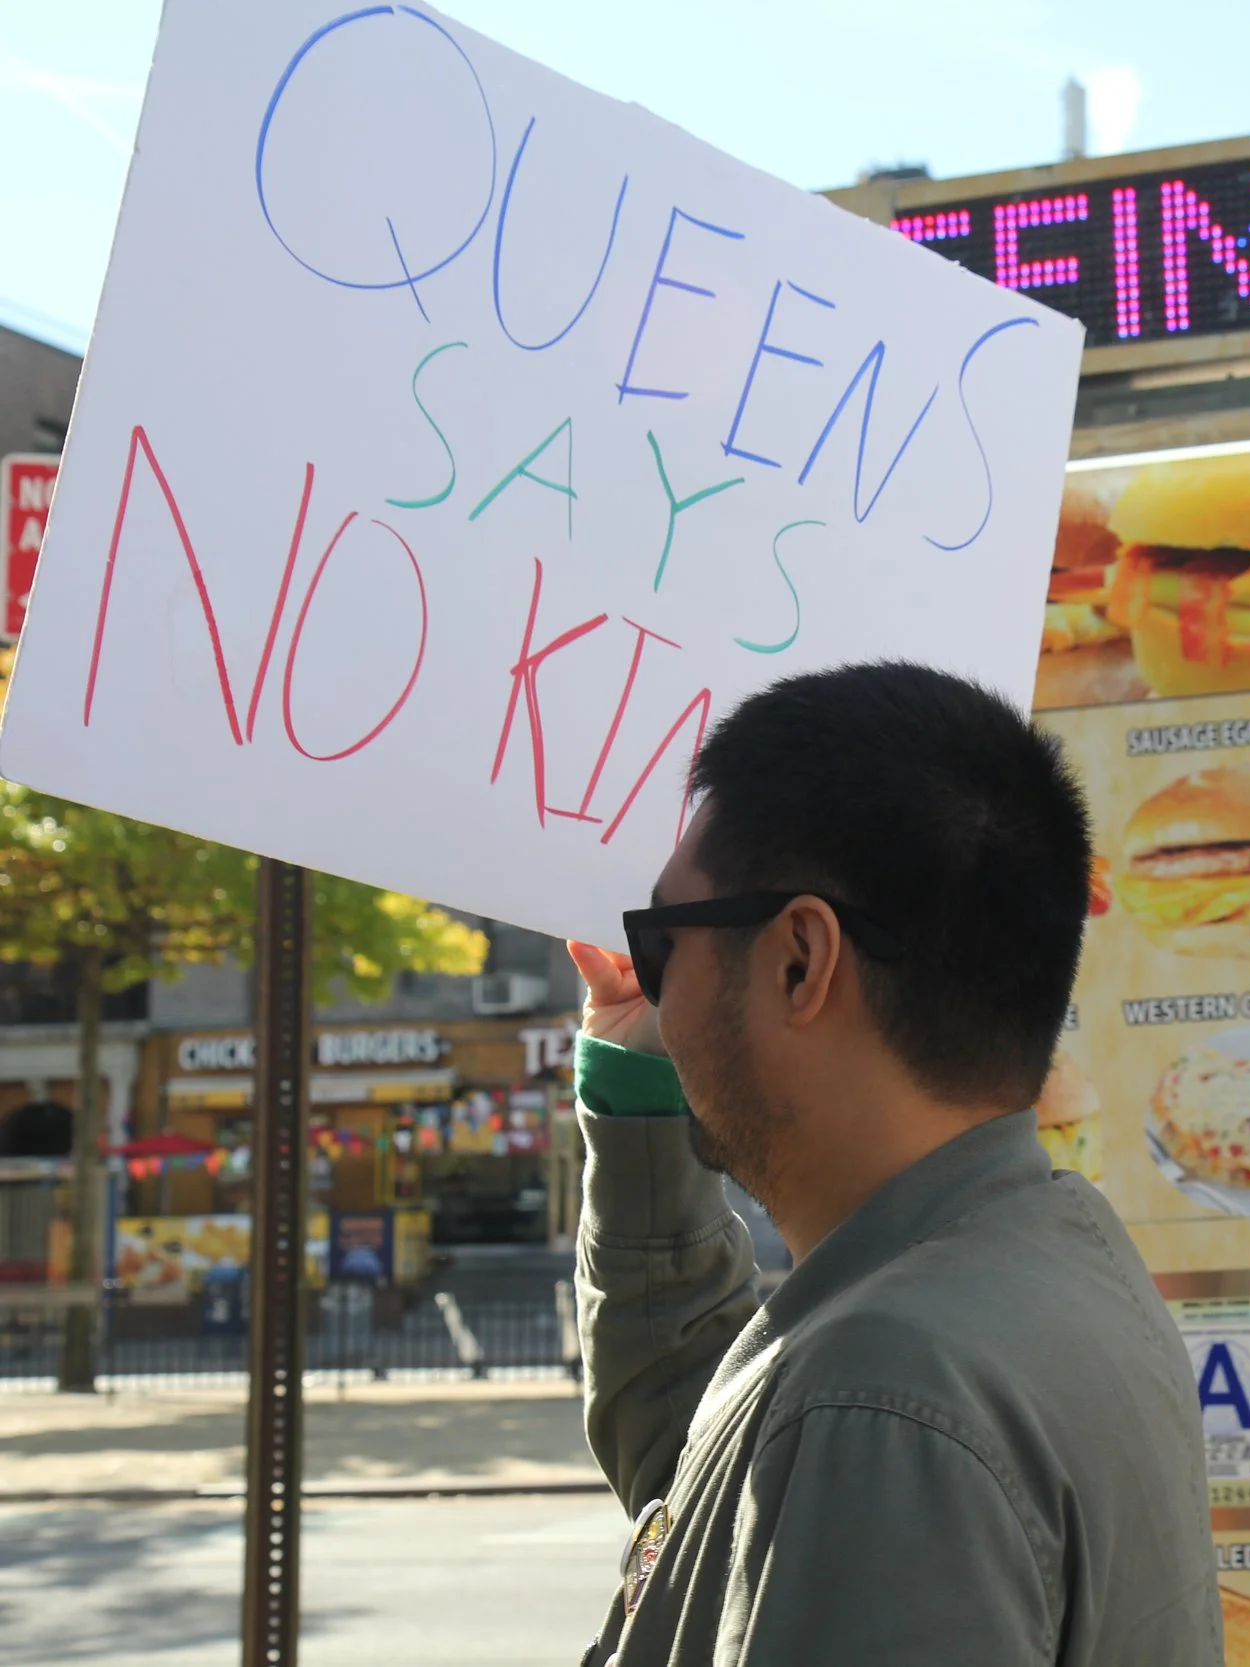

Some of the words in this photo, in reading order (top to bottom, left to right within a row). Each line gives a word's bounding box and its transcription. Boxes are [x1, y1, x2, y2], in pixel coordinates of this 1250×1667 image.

[256, 5, 1040, 551] QUEENS
[384, 341, 827, 654] SAYS
[84, 424, 428, 762] NO
[489, 556, 712, 851] KIN
[1127, 722, 1218, 756] SAUSAGE
[179, 1037, 256, 1070] CHICK
[318, 1029, 439, 1066] BURGERS
[1123, 994, 1236, 1026] WESTERN
